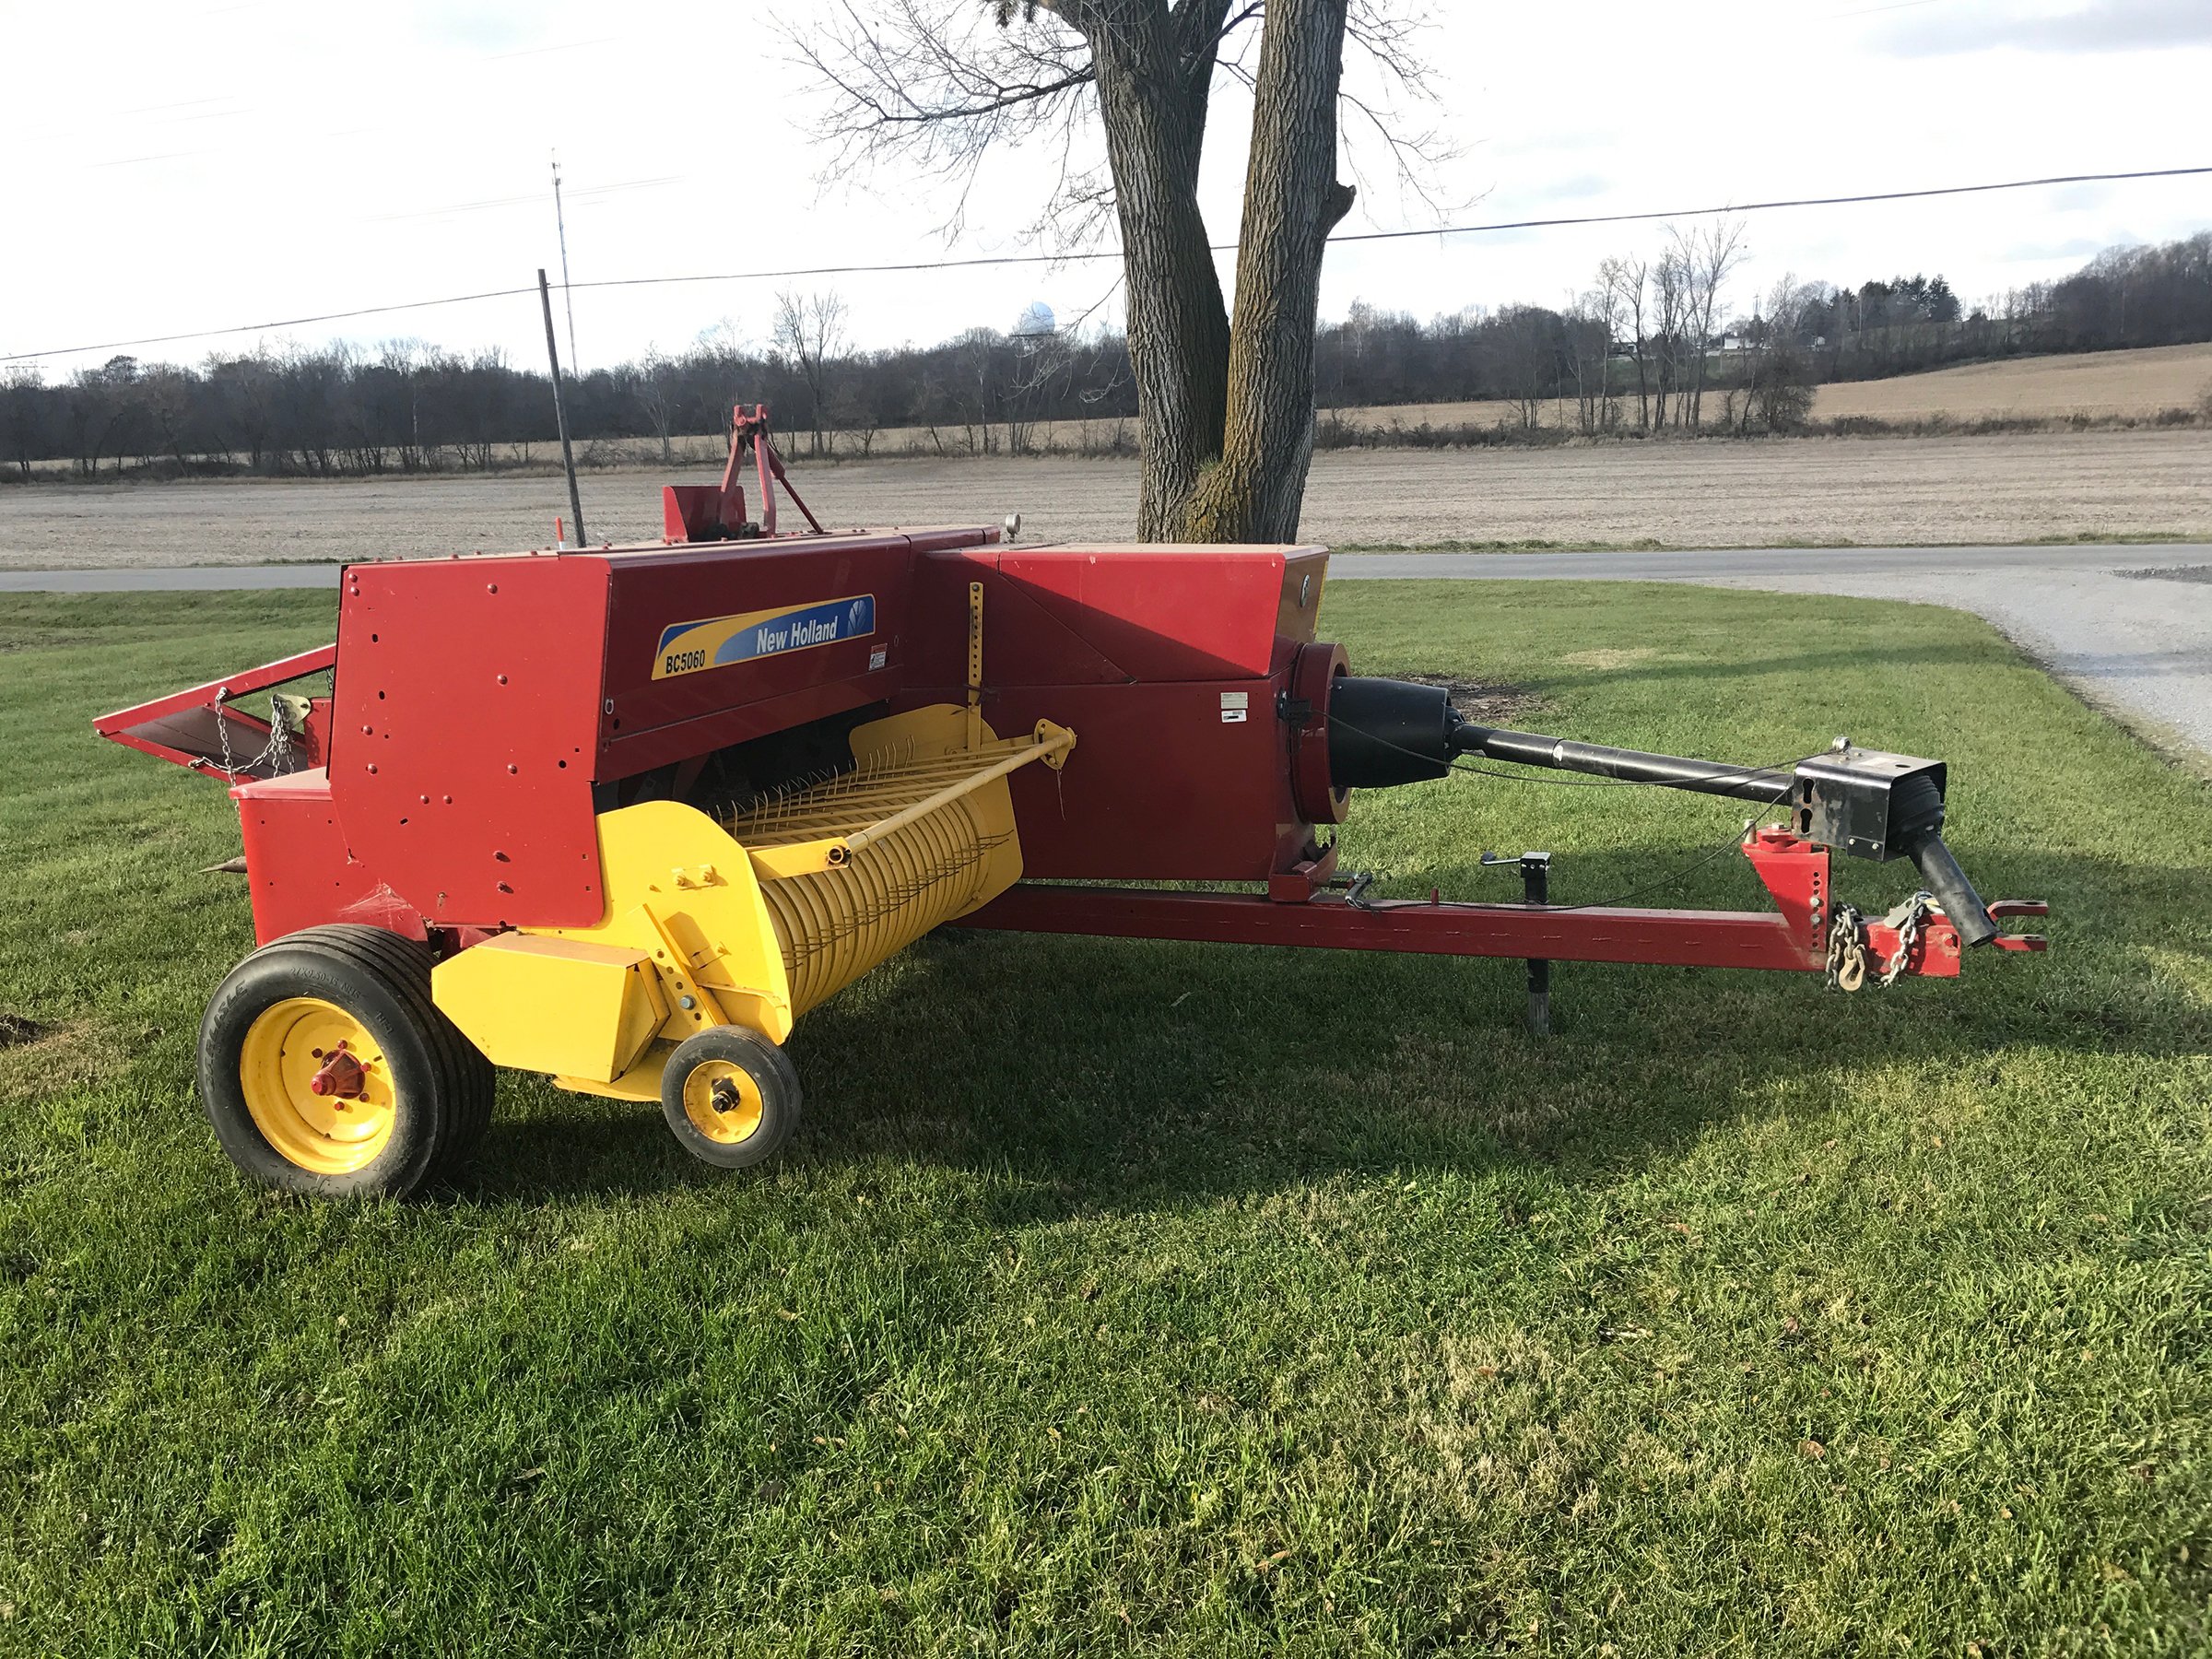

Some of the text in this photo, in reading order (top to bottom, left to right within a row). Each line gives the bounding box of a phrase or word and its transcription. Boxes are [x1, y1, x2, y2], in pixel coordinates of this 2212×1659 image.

[757, 615, 839, 653] New Holland
[665, 649, 705, 674] BC5060
[205, 980, 248, 1092] CARLISLE
